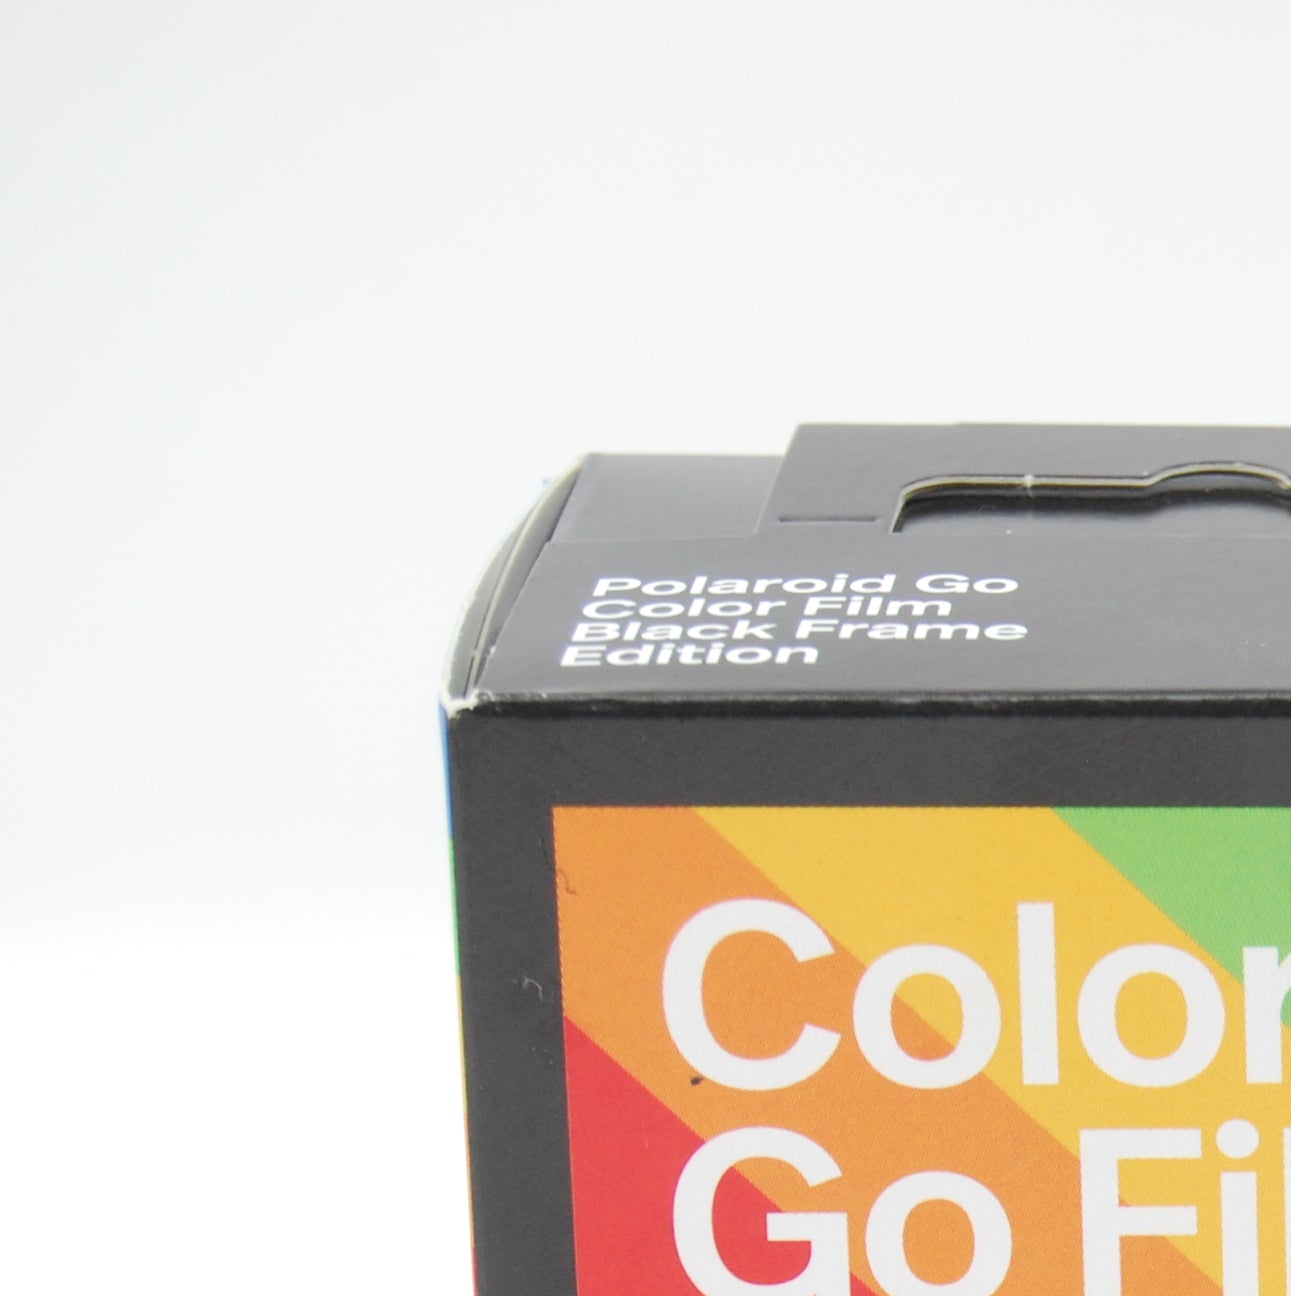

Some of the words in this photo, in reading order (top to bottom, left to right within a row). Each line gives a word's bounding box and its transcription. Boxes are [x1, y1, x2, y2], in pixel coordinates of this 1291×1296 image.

[592, 573, 897, 597] Polaroid
[915, 573, 1019, 595] Go
[581, 597, 788, 619] Color
[803, 596, 953, 617] Film
[570, 620, 778, 643] Black
[795, 619, 1028, 641] Frame
[560, 643, 820, 667] Edition
